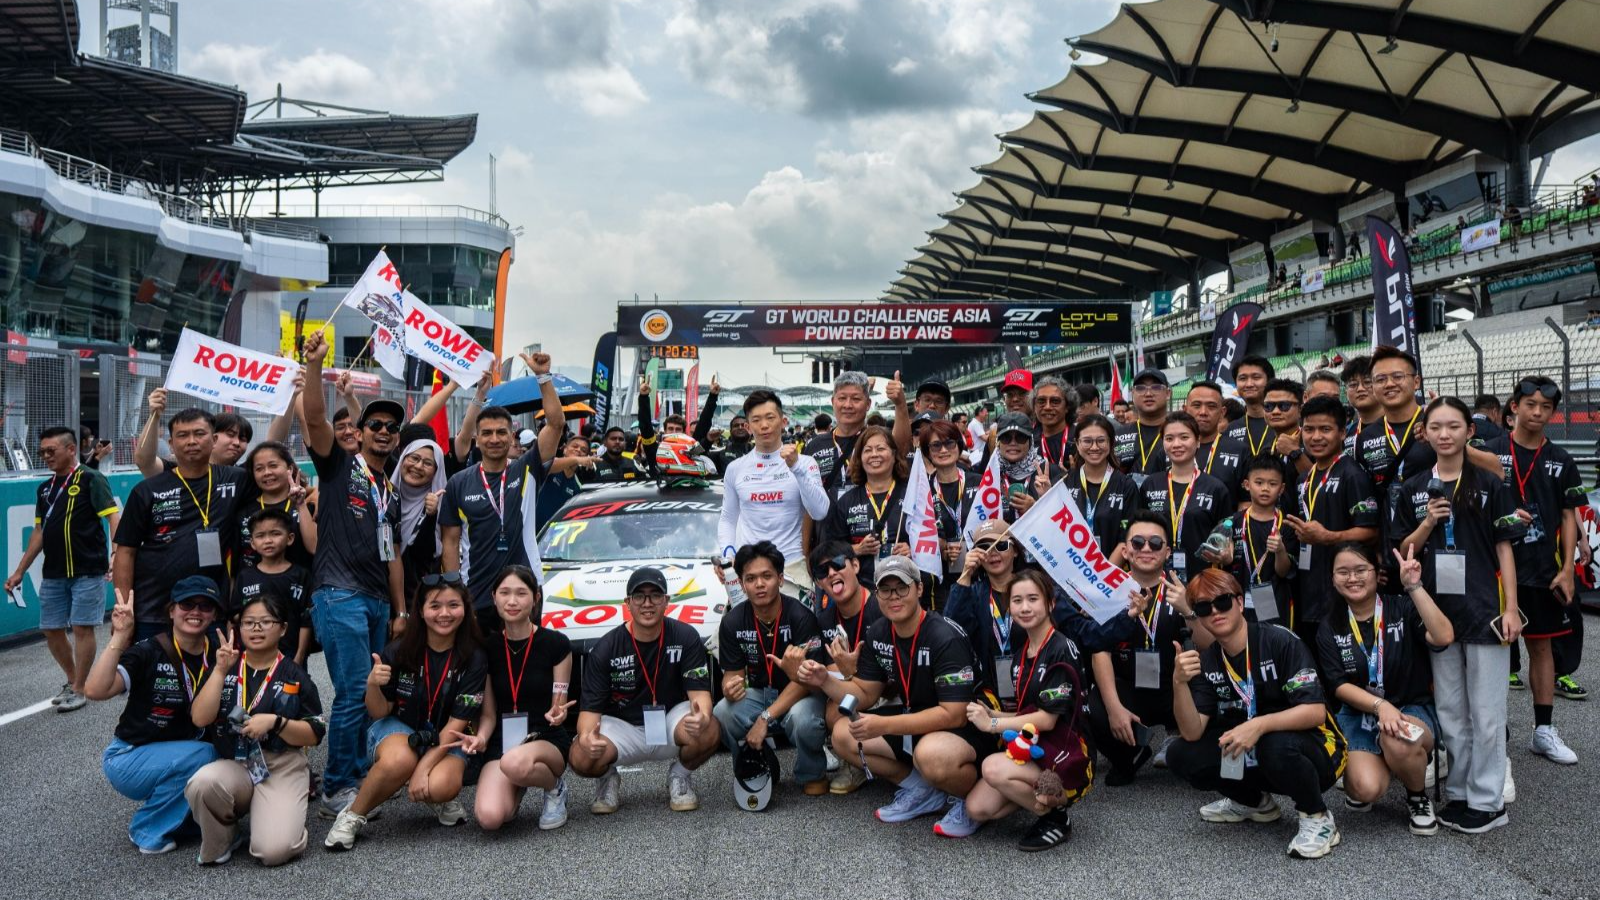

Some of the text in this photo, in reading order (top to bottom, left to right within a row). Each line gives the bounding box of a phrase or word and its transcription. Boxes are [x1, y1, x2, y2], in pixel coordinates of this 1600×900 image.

[703, 309, 755, 322] GT
[766, 308, 991, 324] GT WORLD CHALLENGE ASIA
[1003, 308, 1054, 322] GT
[1060, 313, 1118, 321] LOTUS
[805, 325, 953, 340] POWERED BY AWS
[1060, 322, 1095, 330] CUP
[405, 306, 484, 363] ROWE
[424, 340, 457, 362] MOTOR
[456, 358, 472, 371] OIL
[193, 344, 286, 386] ROWE
[219, 374, 276, 394] MOTOR OIL
[1220, 454, 1239, 468] 77
[1545, 463, 1563, 478] 77
[217, 485, 236, 498] 77
[751, 492, 783, 501] ROWE
[562, 499, 723, 520] GT WORL
[1108, 496, 1124, 510] 77
[1196, 495, 1213, 510] 77
[550, 521, 589, 547] 77
[1050, 502, 1129, 589] ROWE
[585, 563, 694, 575] AXON
[1066, 548, 1113, 599] MOTOR OIL
[290, 585, 303, 600] 77
[736, 629, 757, 638] ROWE
[610, 654, 635, 667] ROWE
[667, 648, 683, 664] 77
